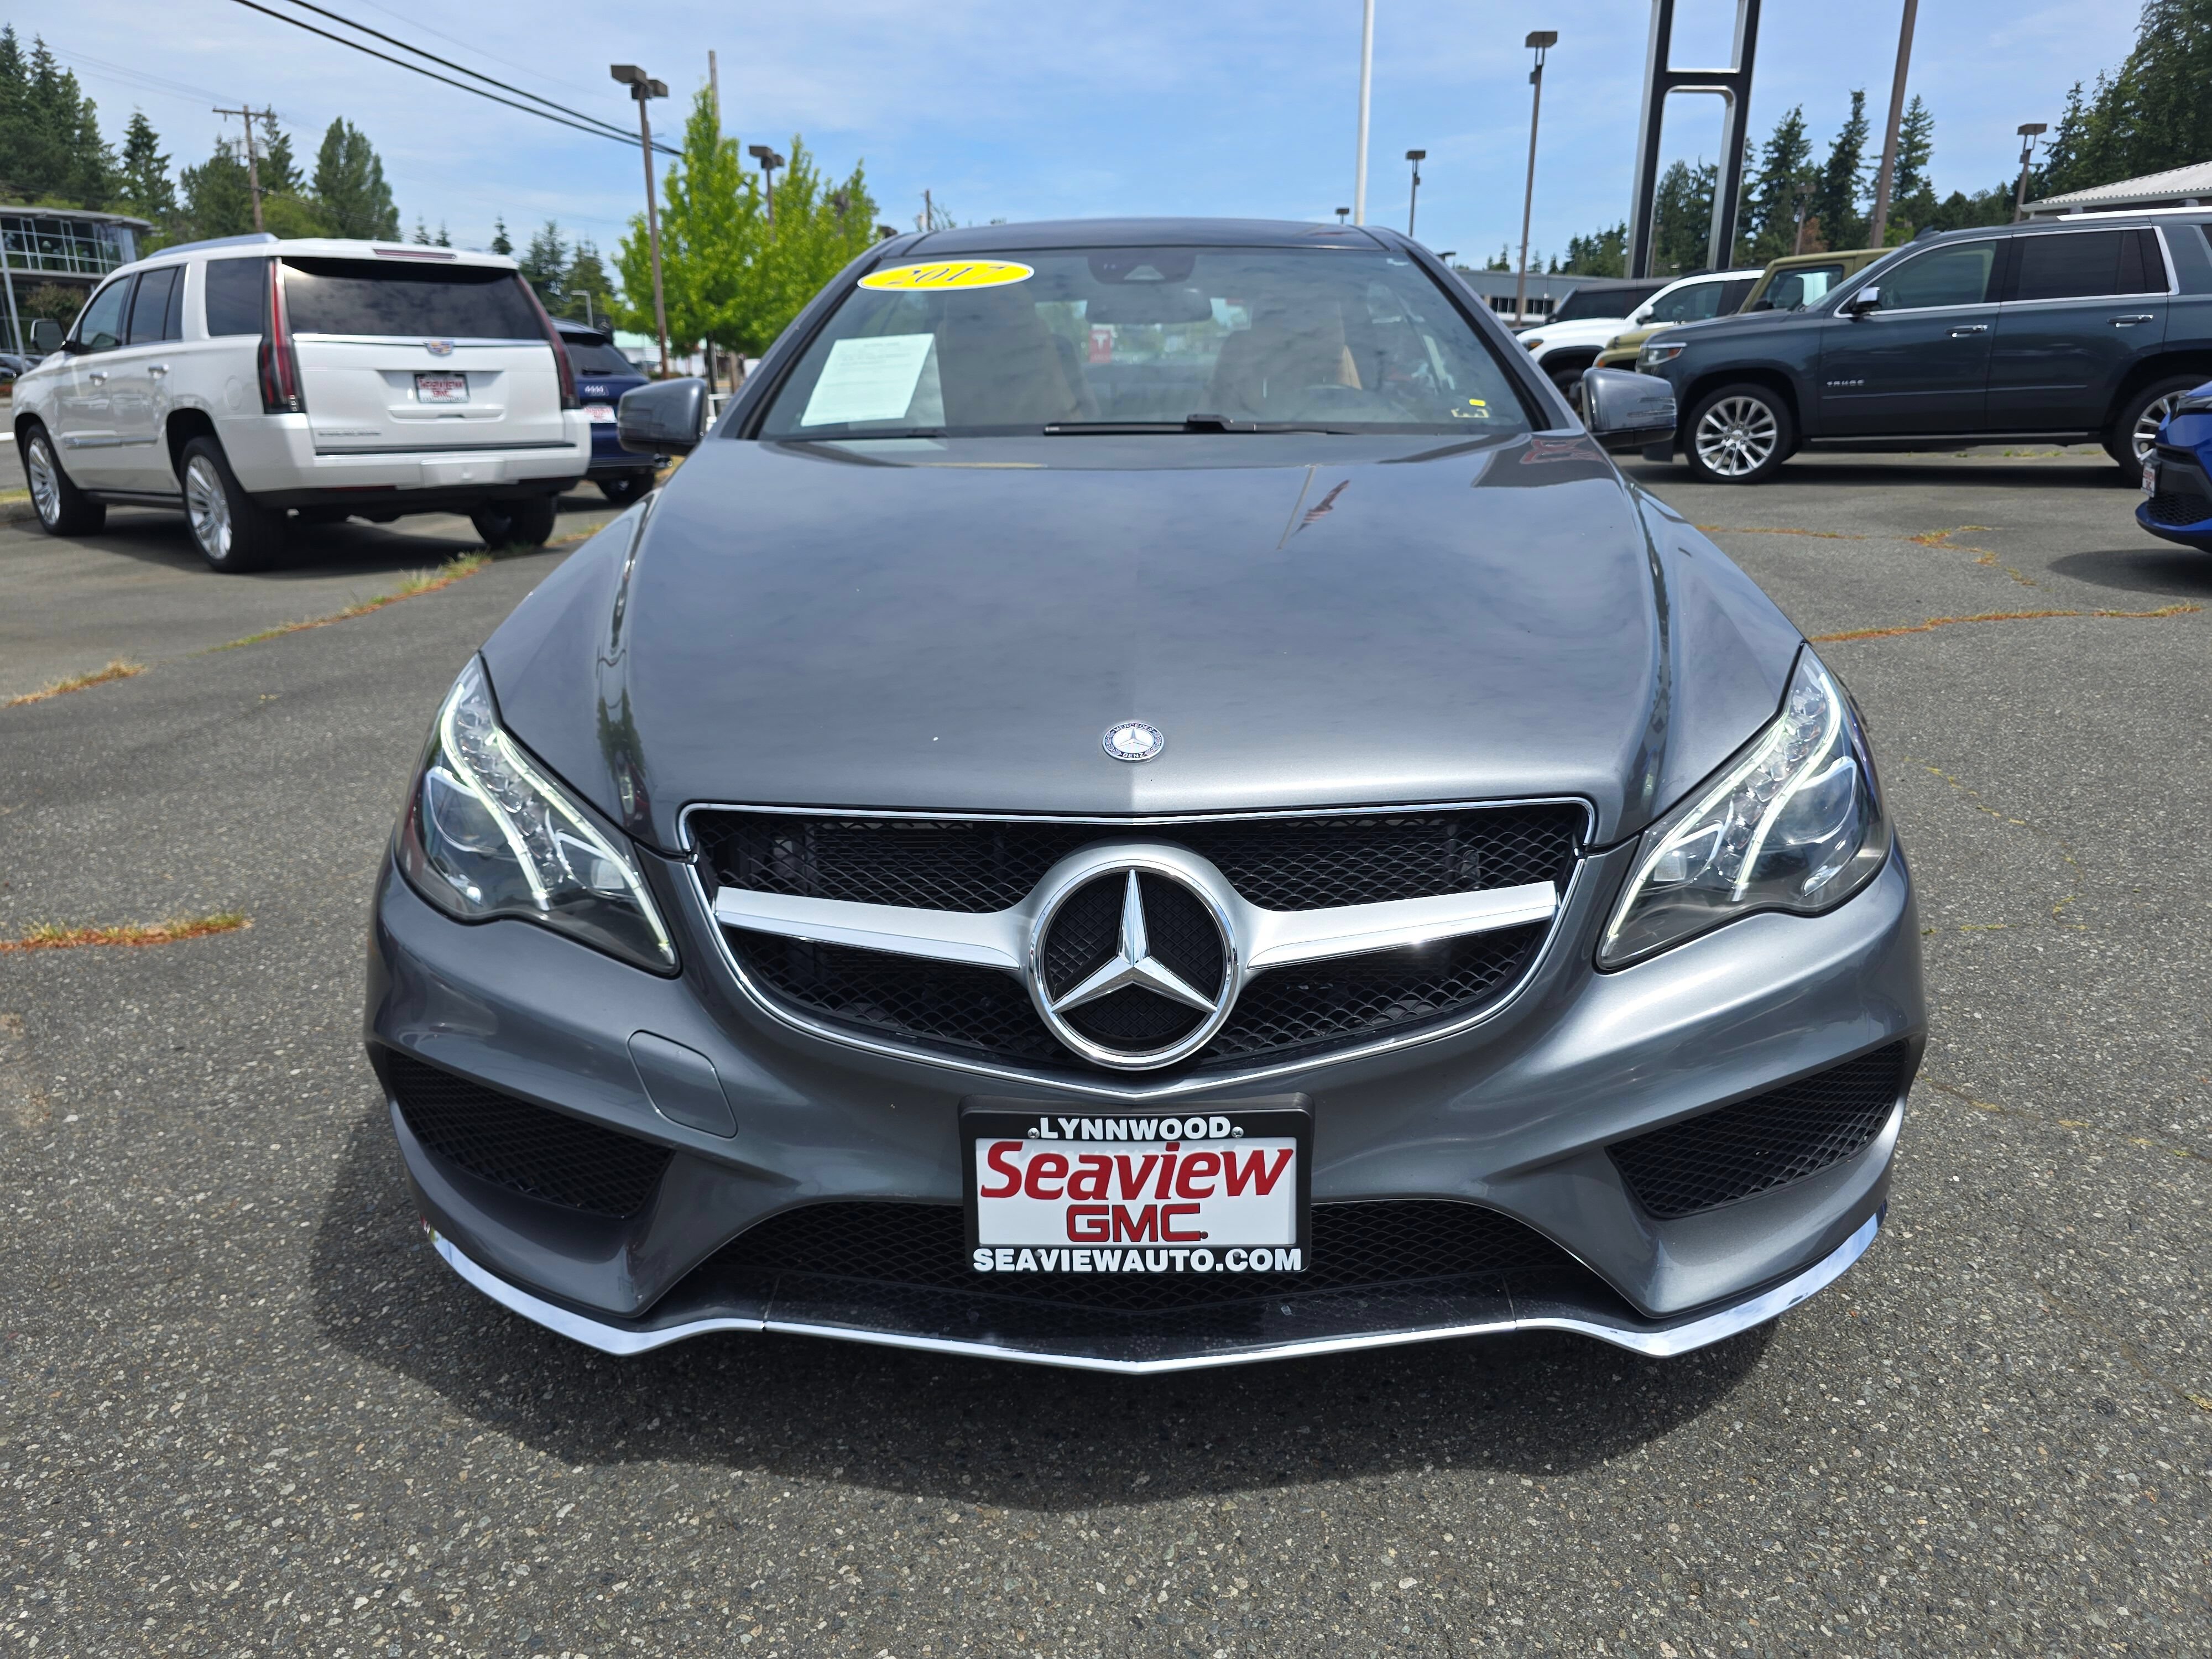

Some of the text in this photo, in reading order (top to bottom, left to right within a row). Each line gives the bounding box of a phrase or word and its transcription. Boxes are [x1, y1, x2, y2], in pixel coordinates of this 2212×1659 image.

[1114, 723, 1154, 732] MERCEDES
[1040, 1117, 1231, 1140] LYNNWOOD
[980, 1141, 1294, 1200] Seaview
[1066, 1202, 1202, 1243] GMC
[973, 1248, 1302, 1272] SEAVIEWAUTO.COM
